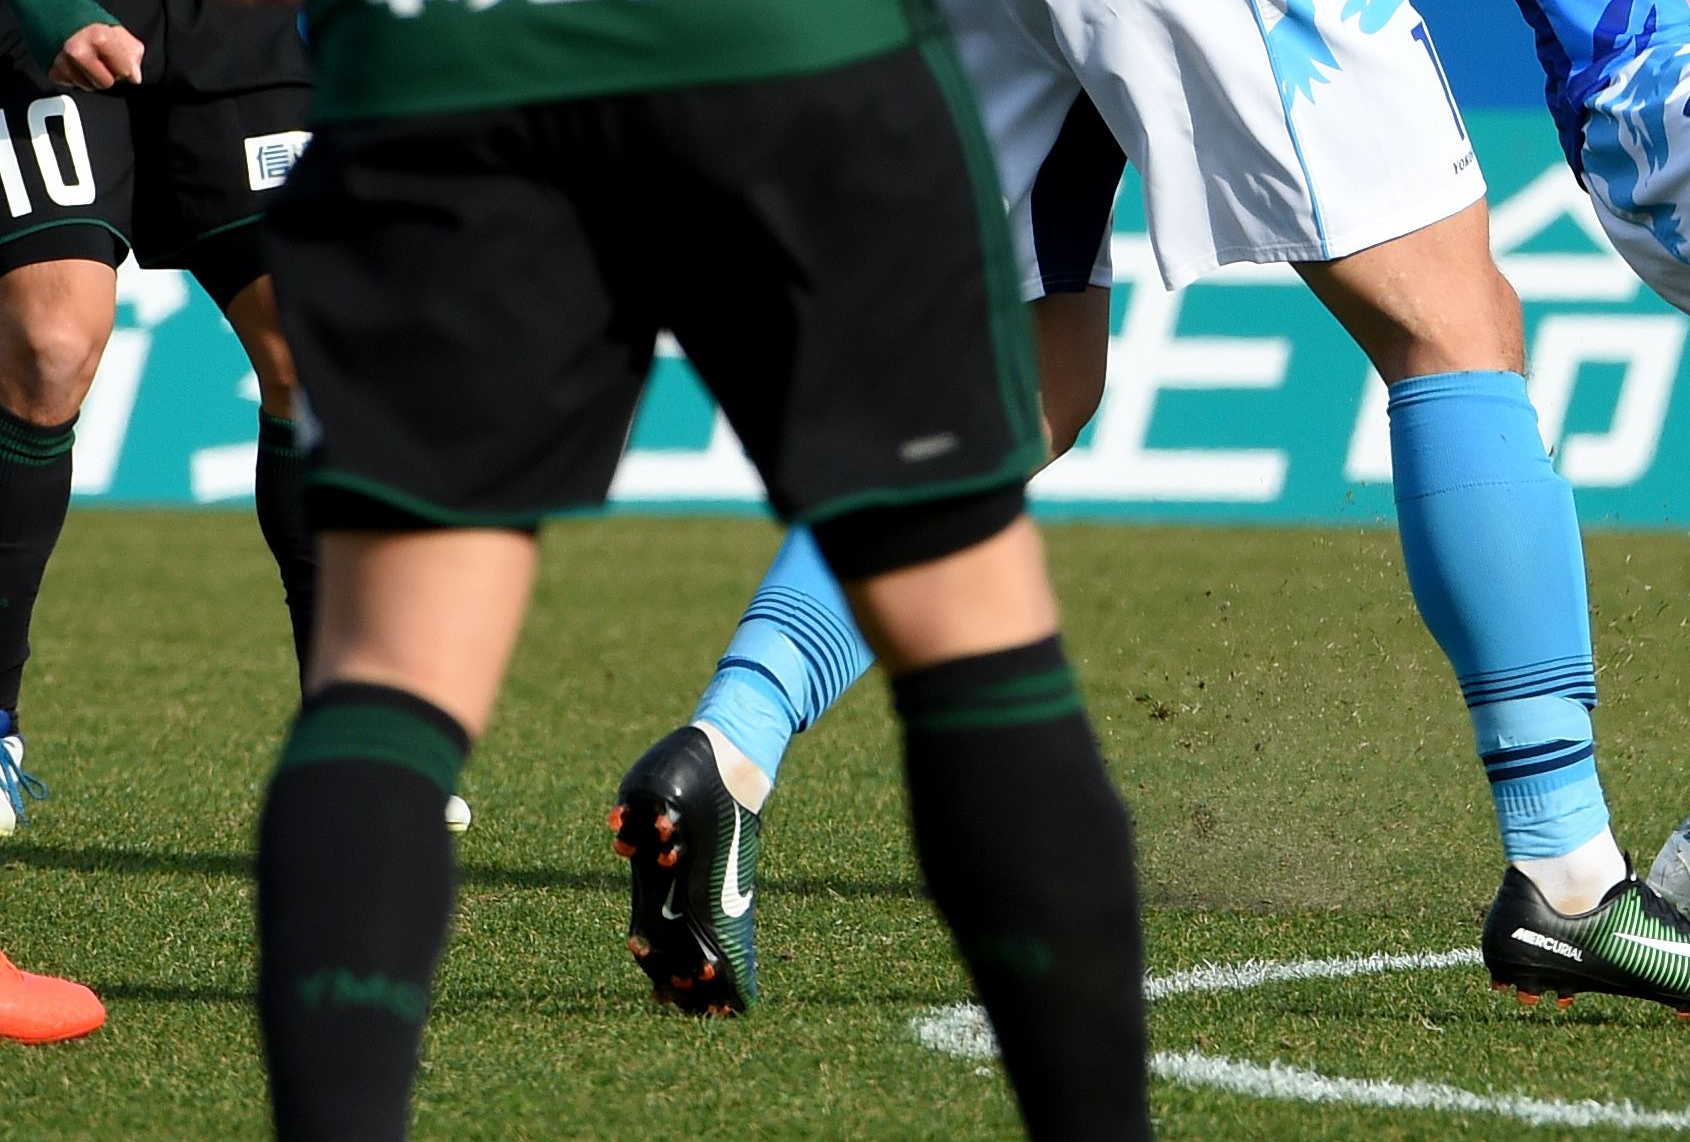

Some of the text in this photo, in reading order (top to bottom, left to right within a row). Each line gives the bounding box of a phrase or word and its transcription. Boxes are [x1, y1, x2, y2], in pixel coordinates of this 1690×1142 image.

[0, 94, 96, 218] 10
[256, 143, 298, 180] 信
[1511, 927, 1584, 963] MERCURIAL
